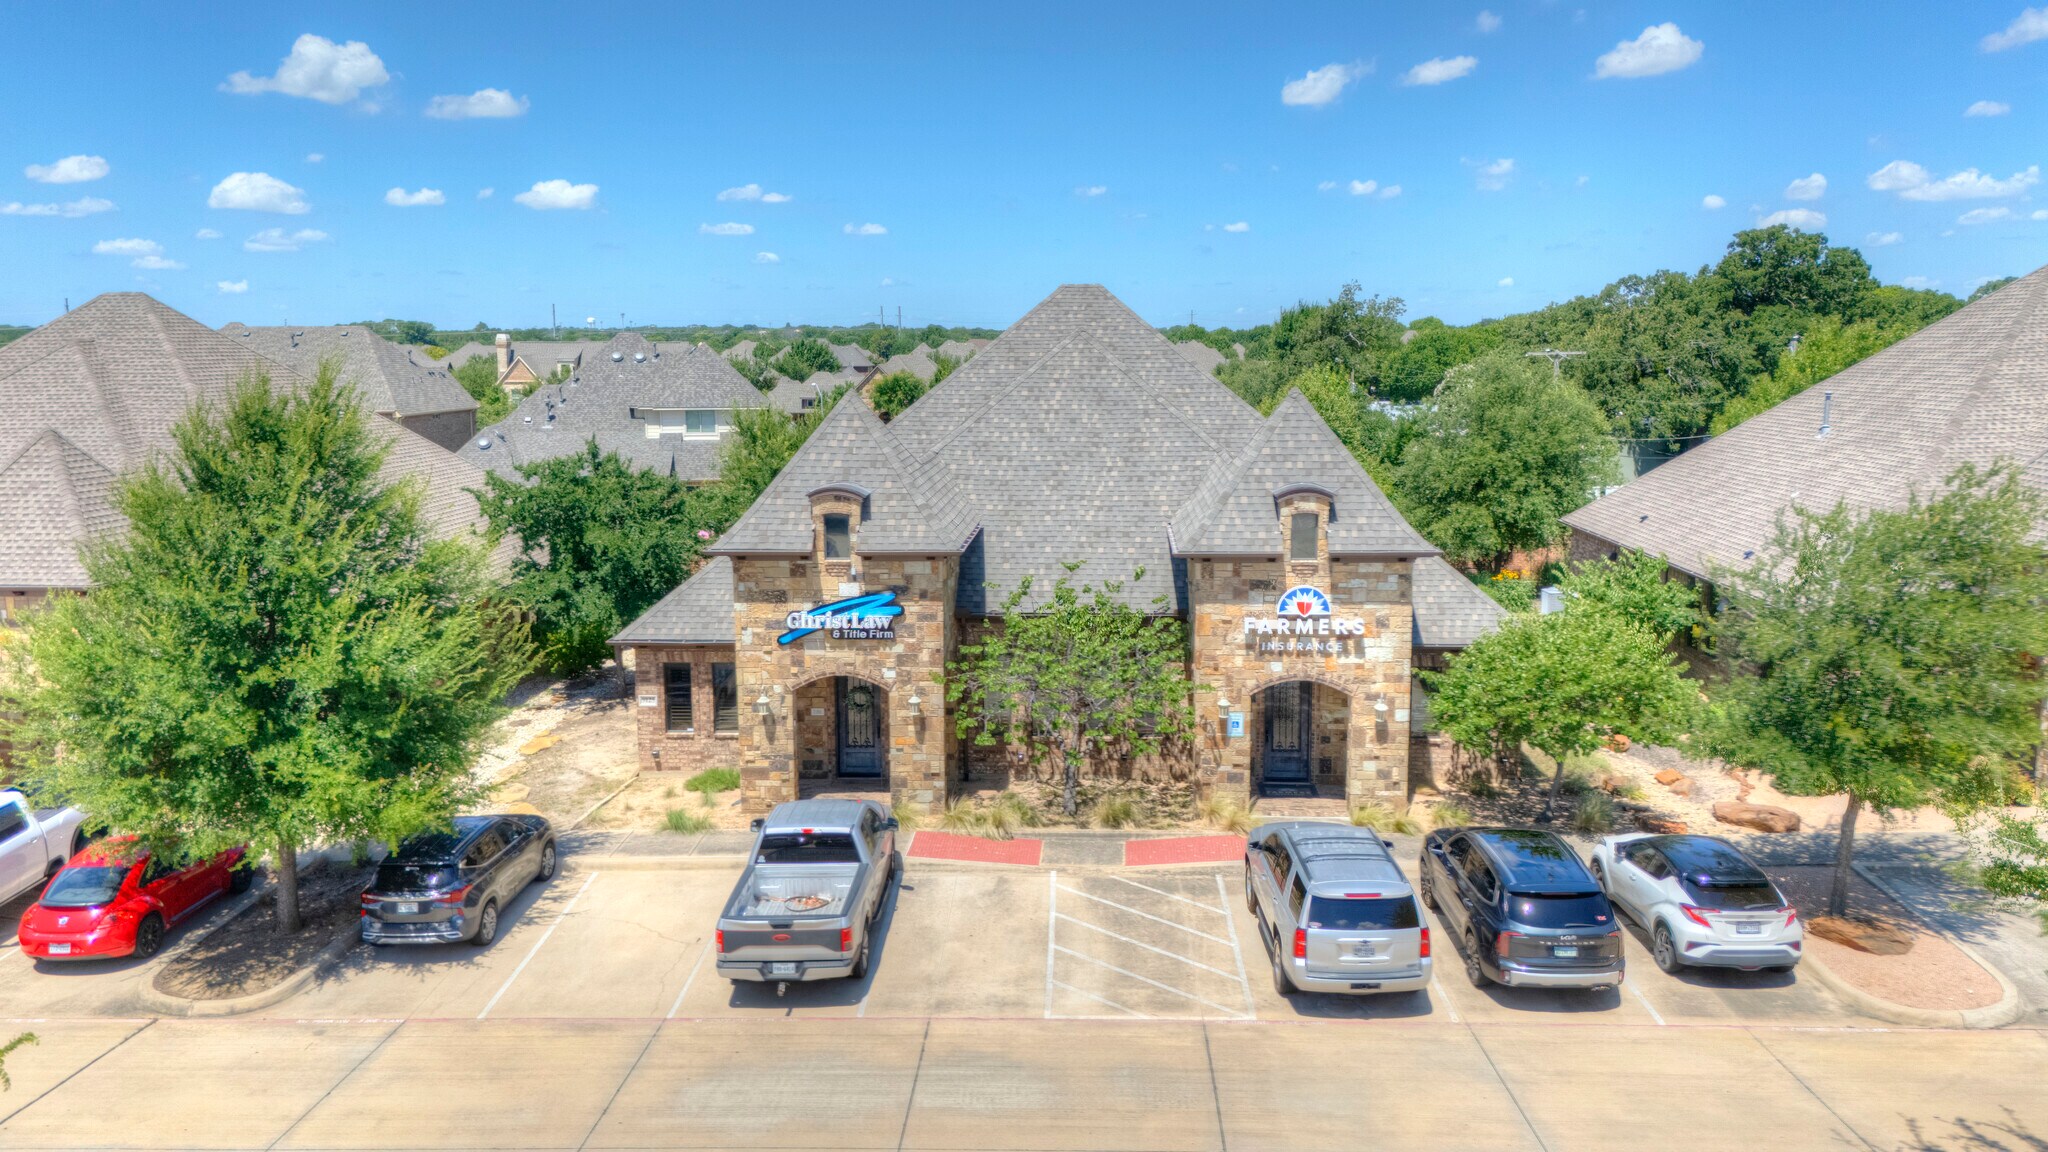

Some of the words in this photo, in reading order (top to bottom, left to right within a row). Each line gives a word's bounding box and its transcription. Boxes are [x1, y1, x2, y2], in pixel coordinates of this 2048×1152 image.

[1243, 617, 1365, 635] FARMERS
[832, 629, 840, 638] &
[843, 629, 866, 638] Title
[869, 629, 894, 638] Firm
[1261, 641, 1343, 651] INSURANCE
